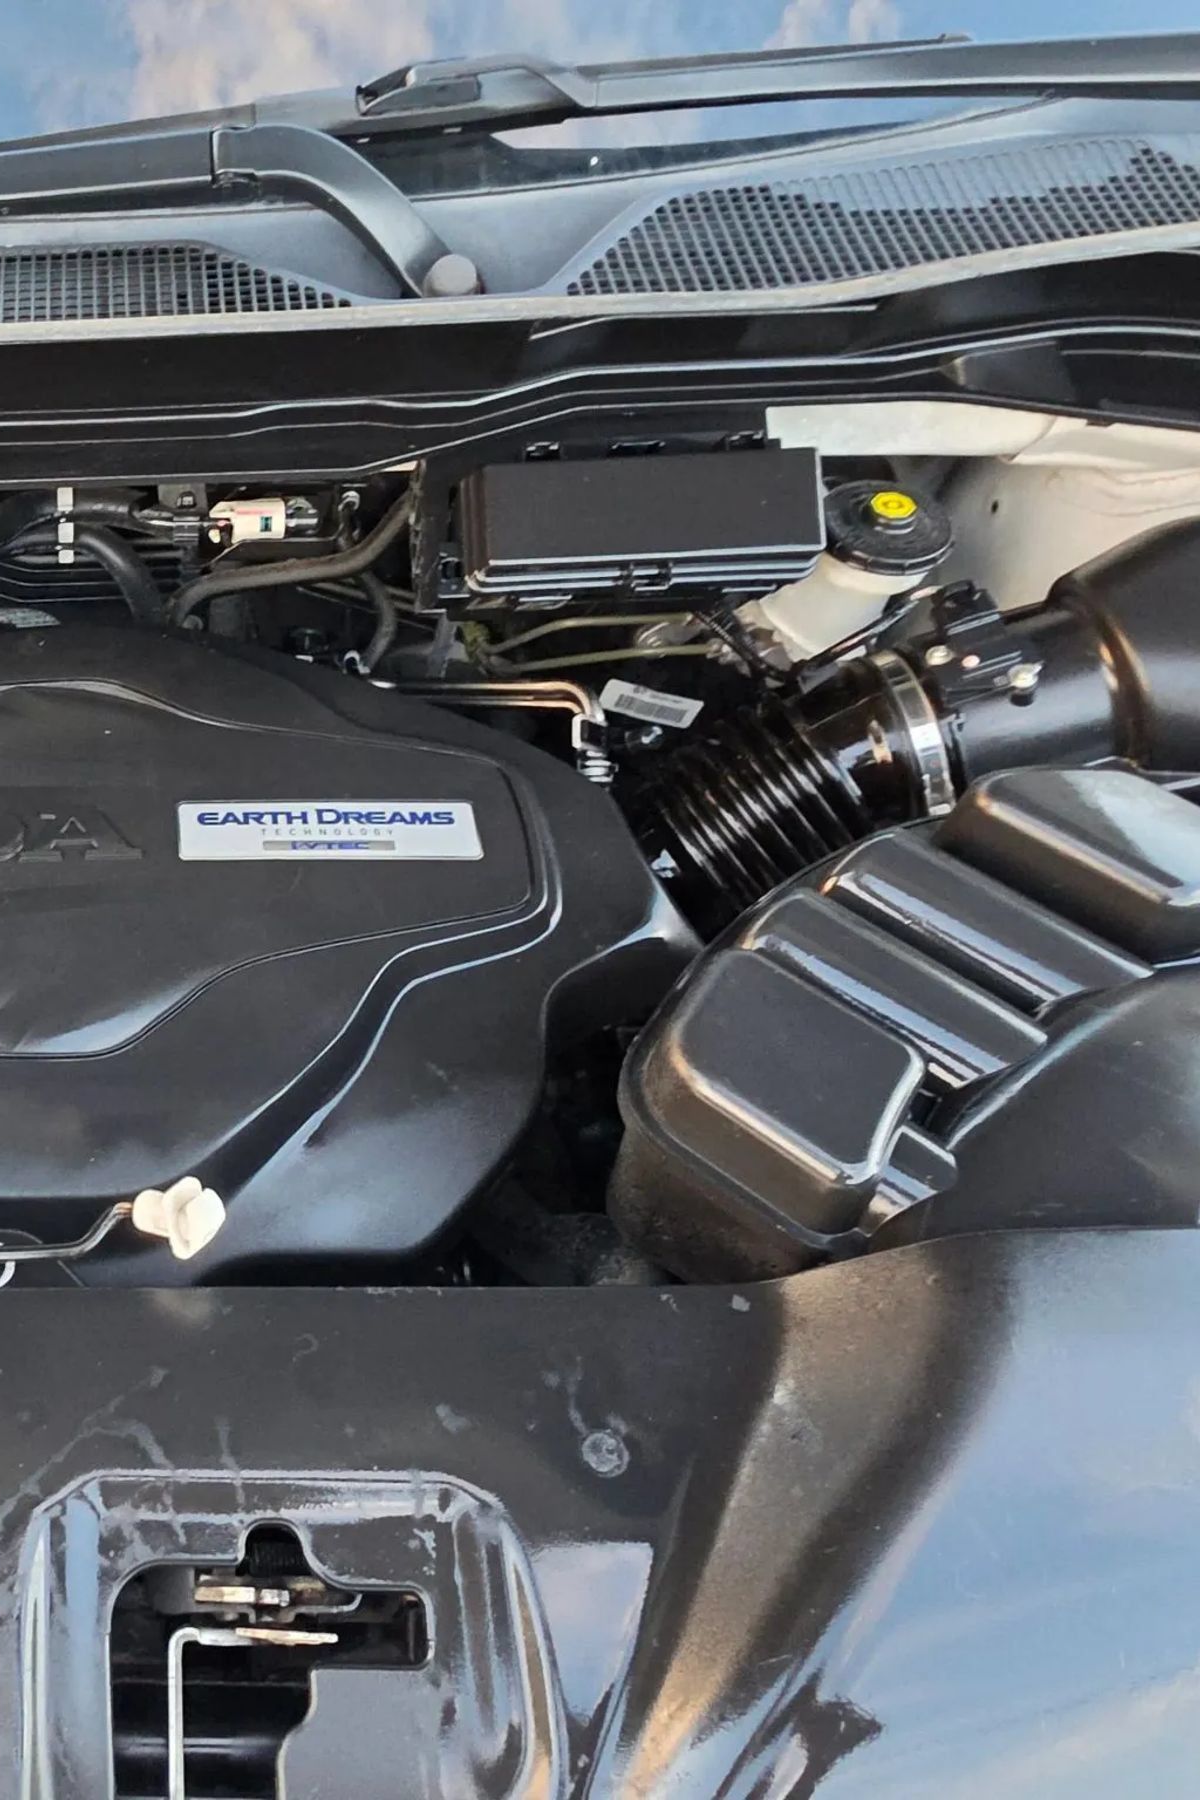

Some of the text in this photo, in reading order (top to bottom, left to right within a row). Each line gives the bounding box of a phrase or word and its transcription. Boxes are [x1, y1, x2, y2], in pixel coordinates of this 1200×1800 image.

[197, 808, 455, 825] EARTH DREAMS
[261, 828, 394, 836] TECHNOLOGY
